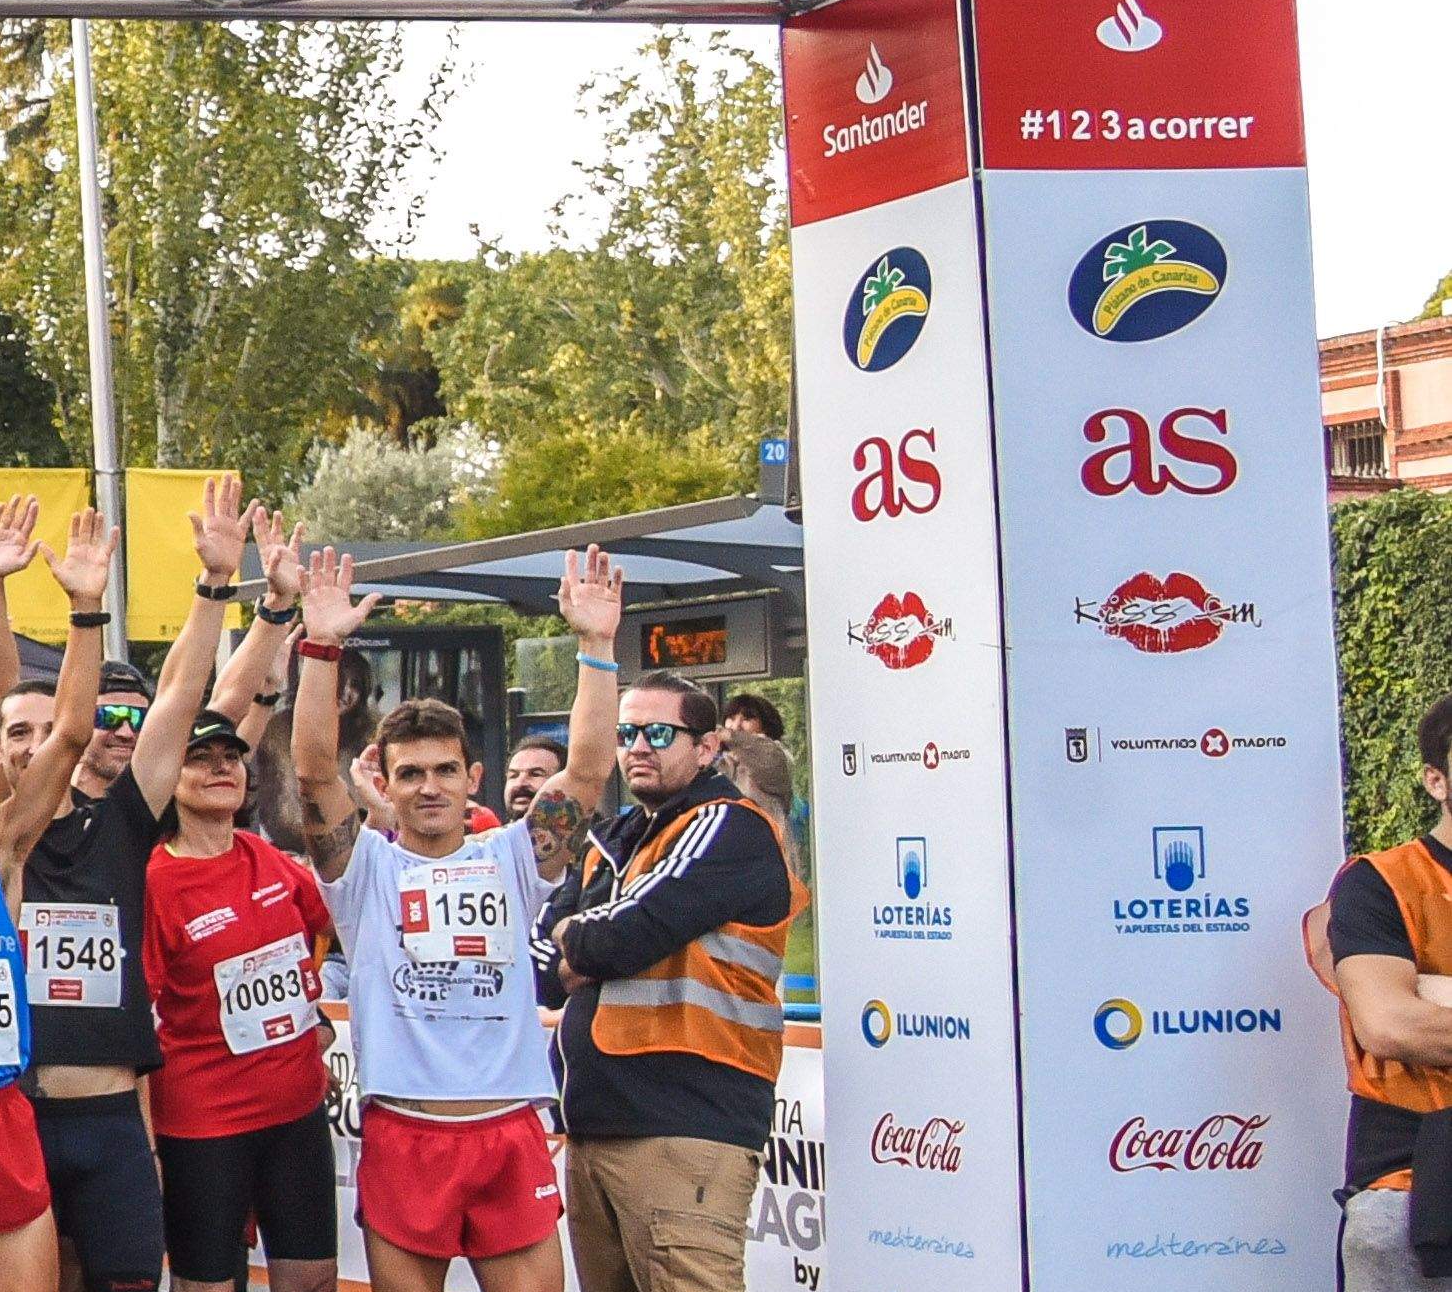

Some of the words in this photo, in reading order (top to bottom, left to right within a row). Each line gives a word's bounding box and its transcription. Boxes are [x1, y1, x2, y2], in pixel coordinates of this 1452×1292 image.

[822, 100, 928, 159] Santander
[1079, 407, 1239, 498] as
[850, 426, 943, 523] as
[408, 900, 423, 924] 10K
[434, 891, 508, 927] 1561
[873, 902, 953, 926] LOTERÍAS
[1113, 892, 1250, 920] LOTERÍAS
[1114, 924, 1124, 934] Y
[1124, 923, 1181, 934] APUESTAS
[1182, 923, 1204, 933] DEL
[1206, 922, 1251, 933] ESTADO
[35, 936, 116, 973] 1548
[223, 968, 302, 1016] 10083
[895, 1014, 972, 1041] ILUNION
[1151, 1008, 1282, 1035] ILUNION
[870, 1112, 967, 1174] Coca-Cola
[1108, 1113, 1272, 1174] Coca-Cola
[793, 1256, 820, 1292] by
